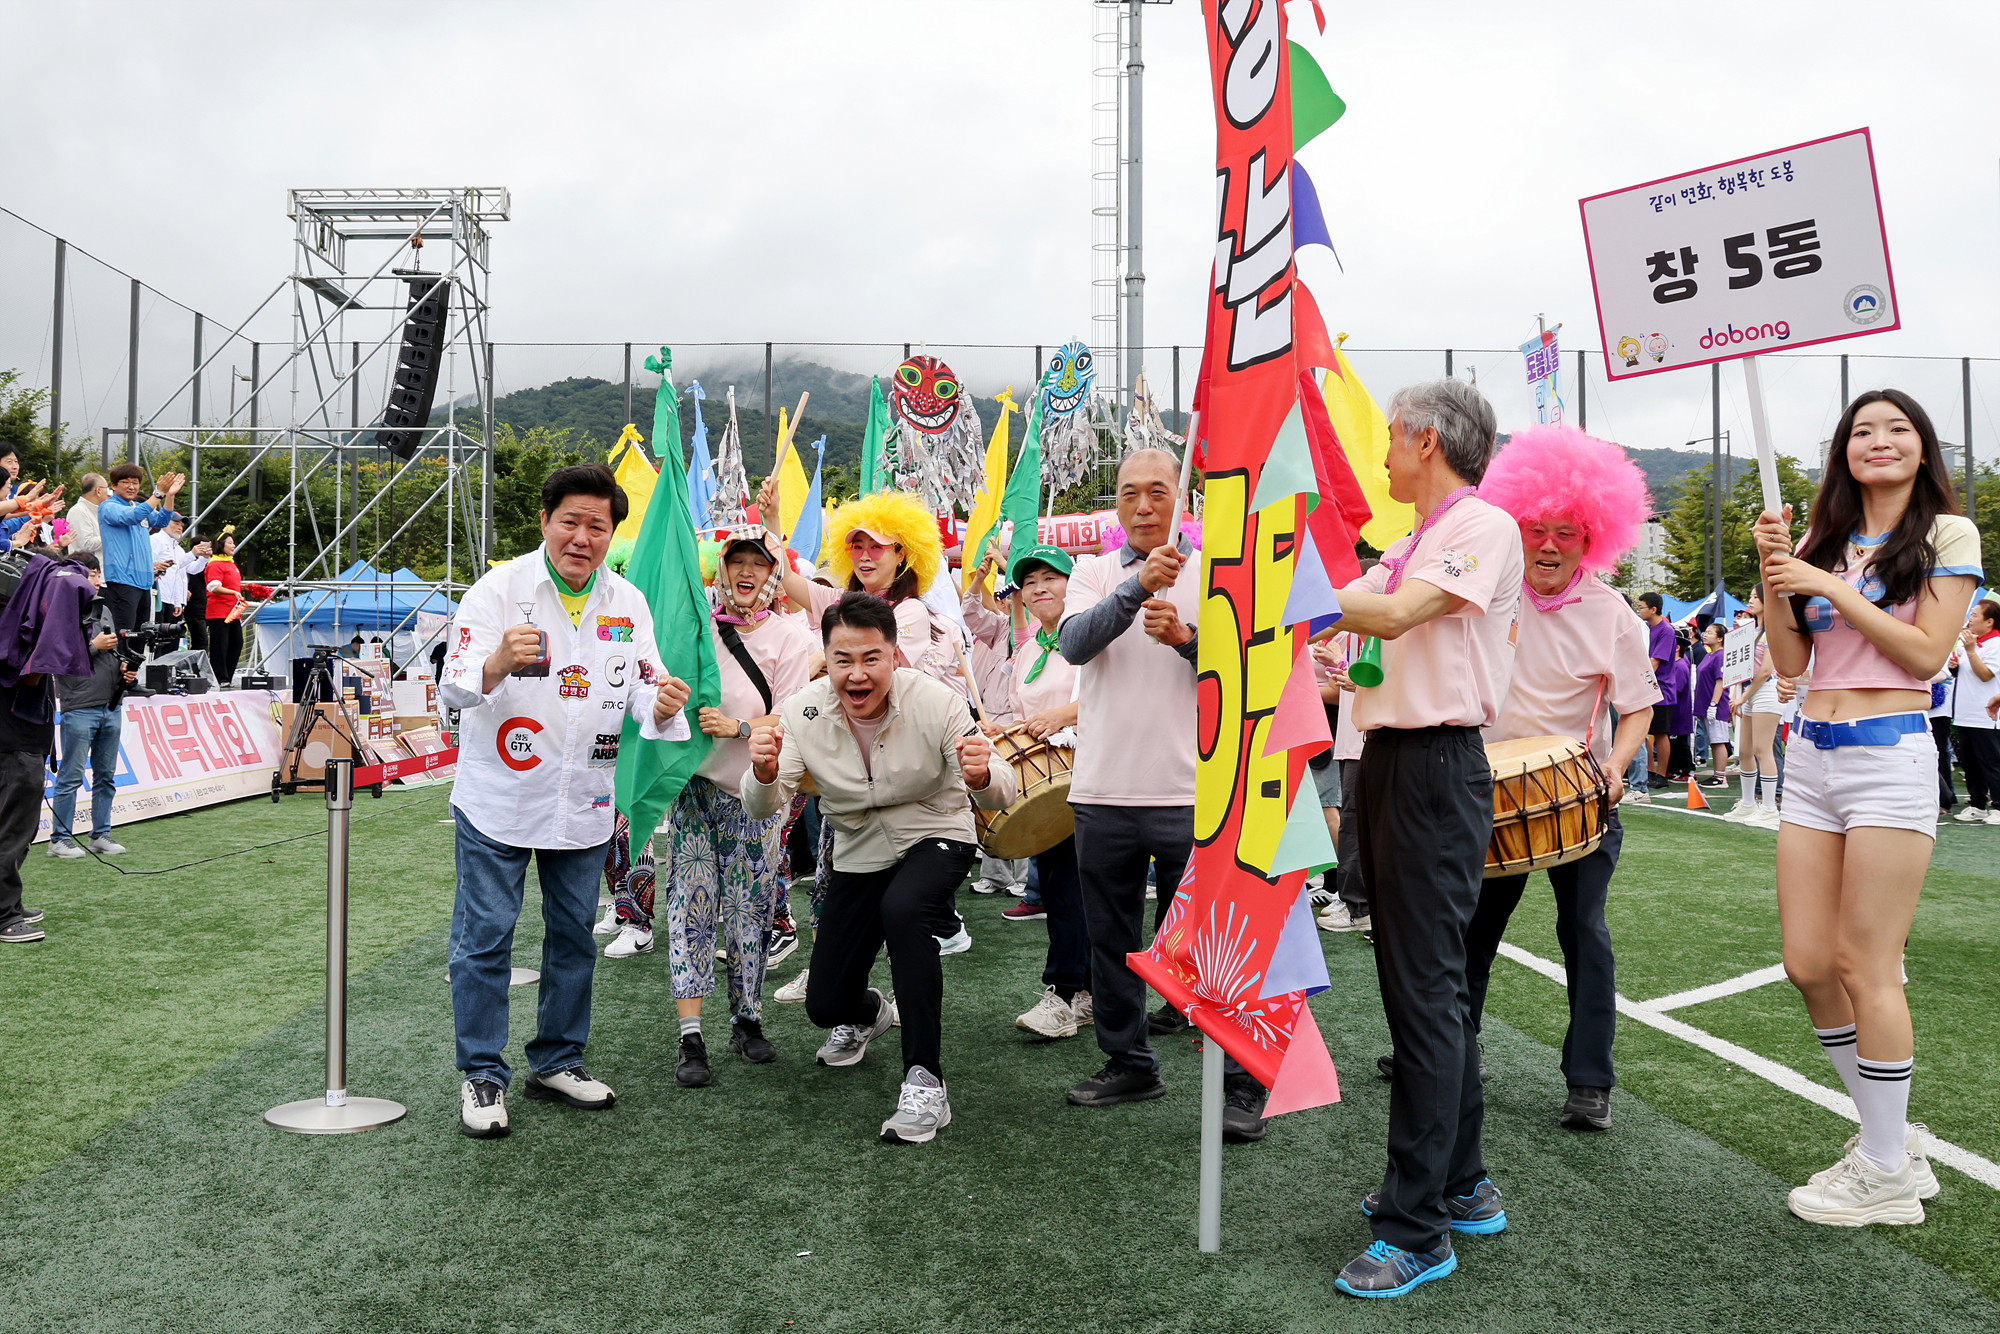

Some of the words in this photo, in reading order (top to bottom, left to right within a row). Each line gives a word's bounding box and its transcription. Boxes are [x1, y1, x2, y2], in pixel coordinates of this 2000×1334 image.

[1649, 193, 1677, 213] 같이
[1681, 181, 1716, 205] 변화,
[1717, 168, 1765, 196] 행복한
[1770, 159, 1794, 182] 도봉
[1645, 246, 1699, 305] 창
[1723, 218, 1823, 290] 5동
[1699, 320, 1790, 349] dobong
[597, 625, 633, 642] GTX
[605, 655, 626, 688] C
[126, 699, 262, 781] 체육대회
[496, 716, 545, 771] C
[511, 741, 532, 753] GTX
